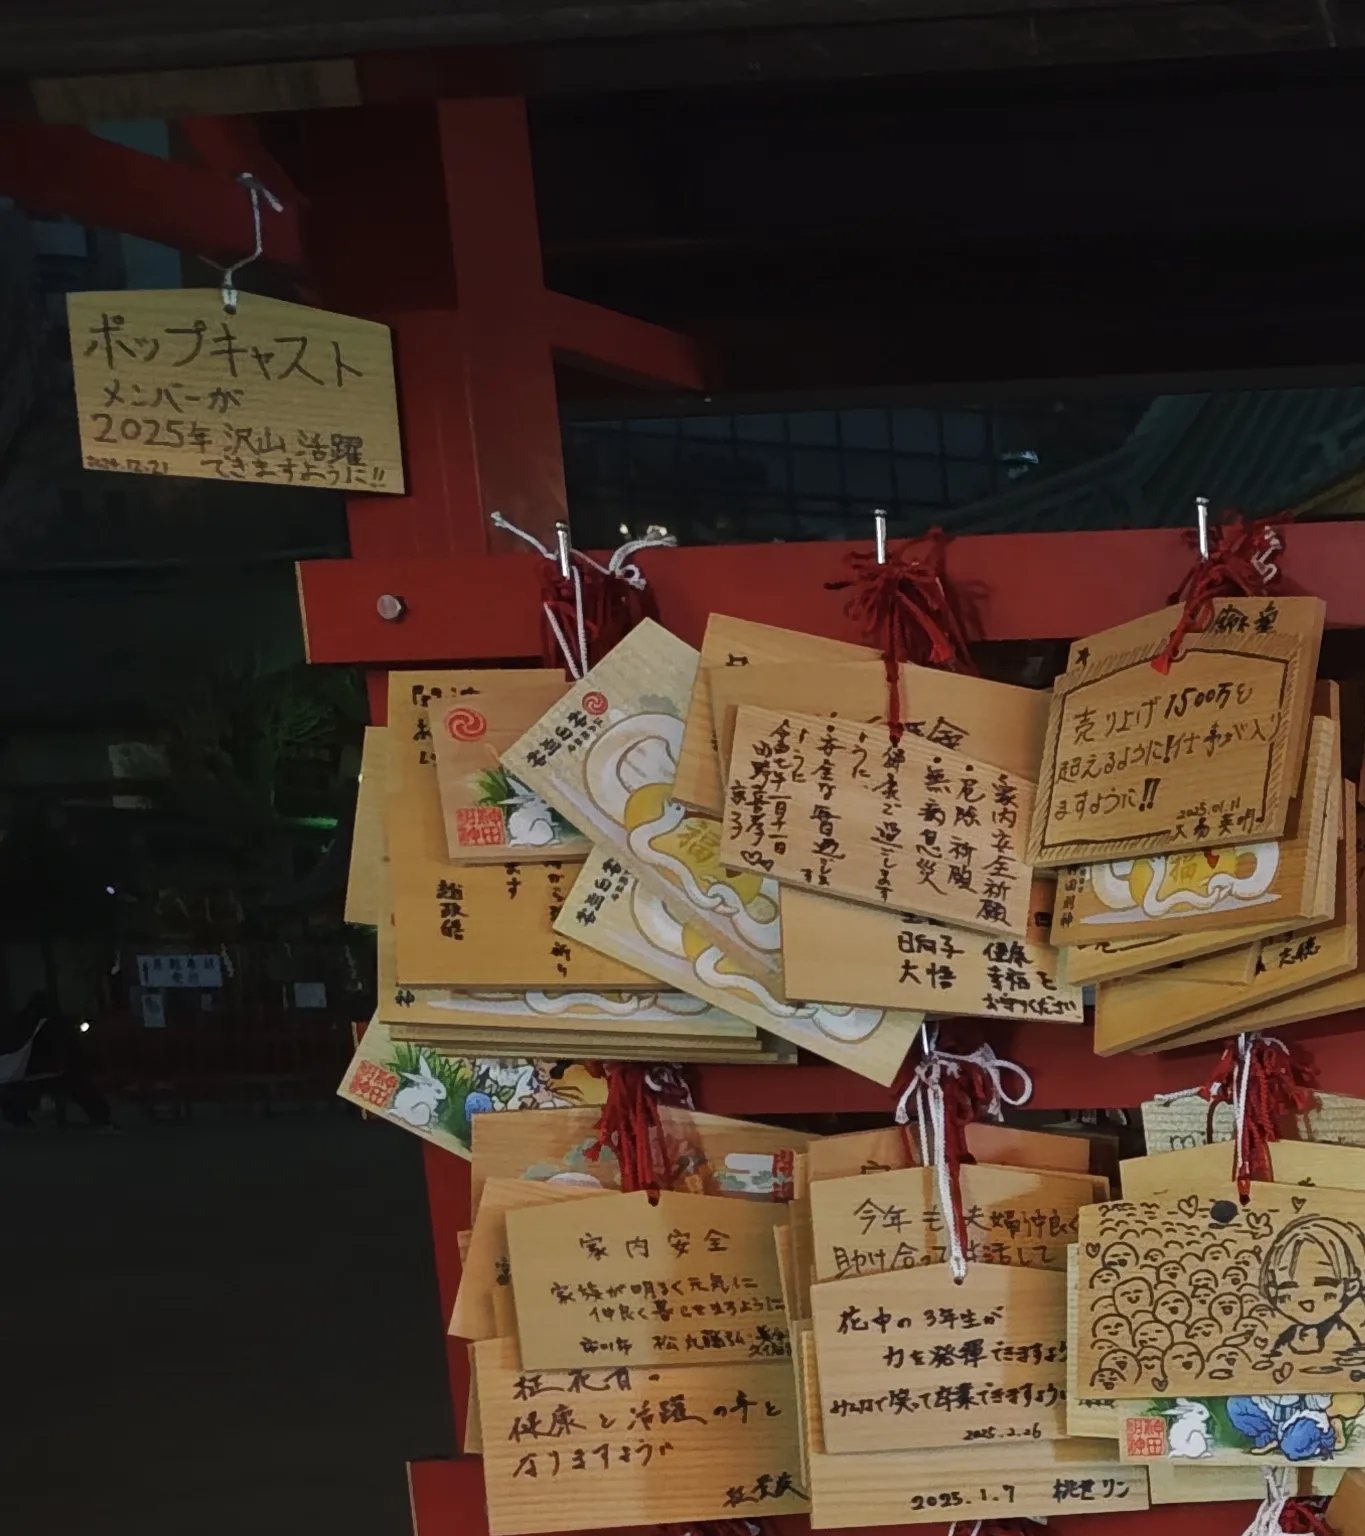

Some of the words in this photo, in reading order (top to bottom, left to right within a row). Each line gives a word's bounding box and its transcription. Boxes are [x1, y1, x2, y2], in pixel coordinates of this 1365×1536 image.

[83, 313, 363, 388] ポップキャスト
